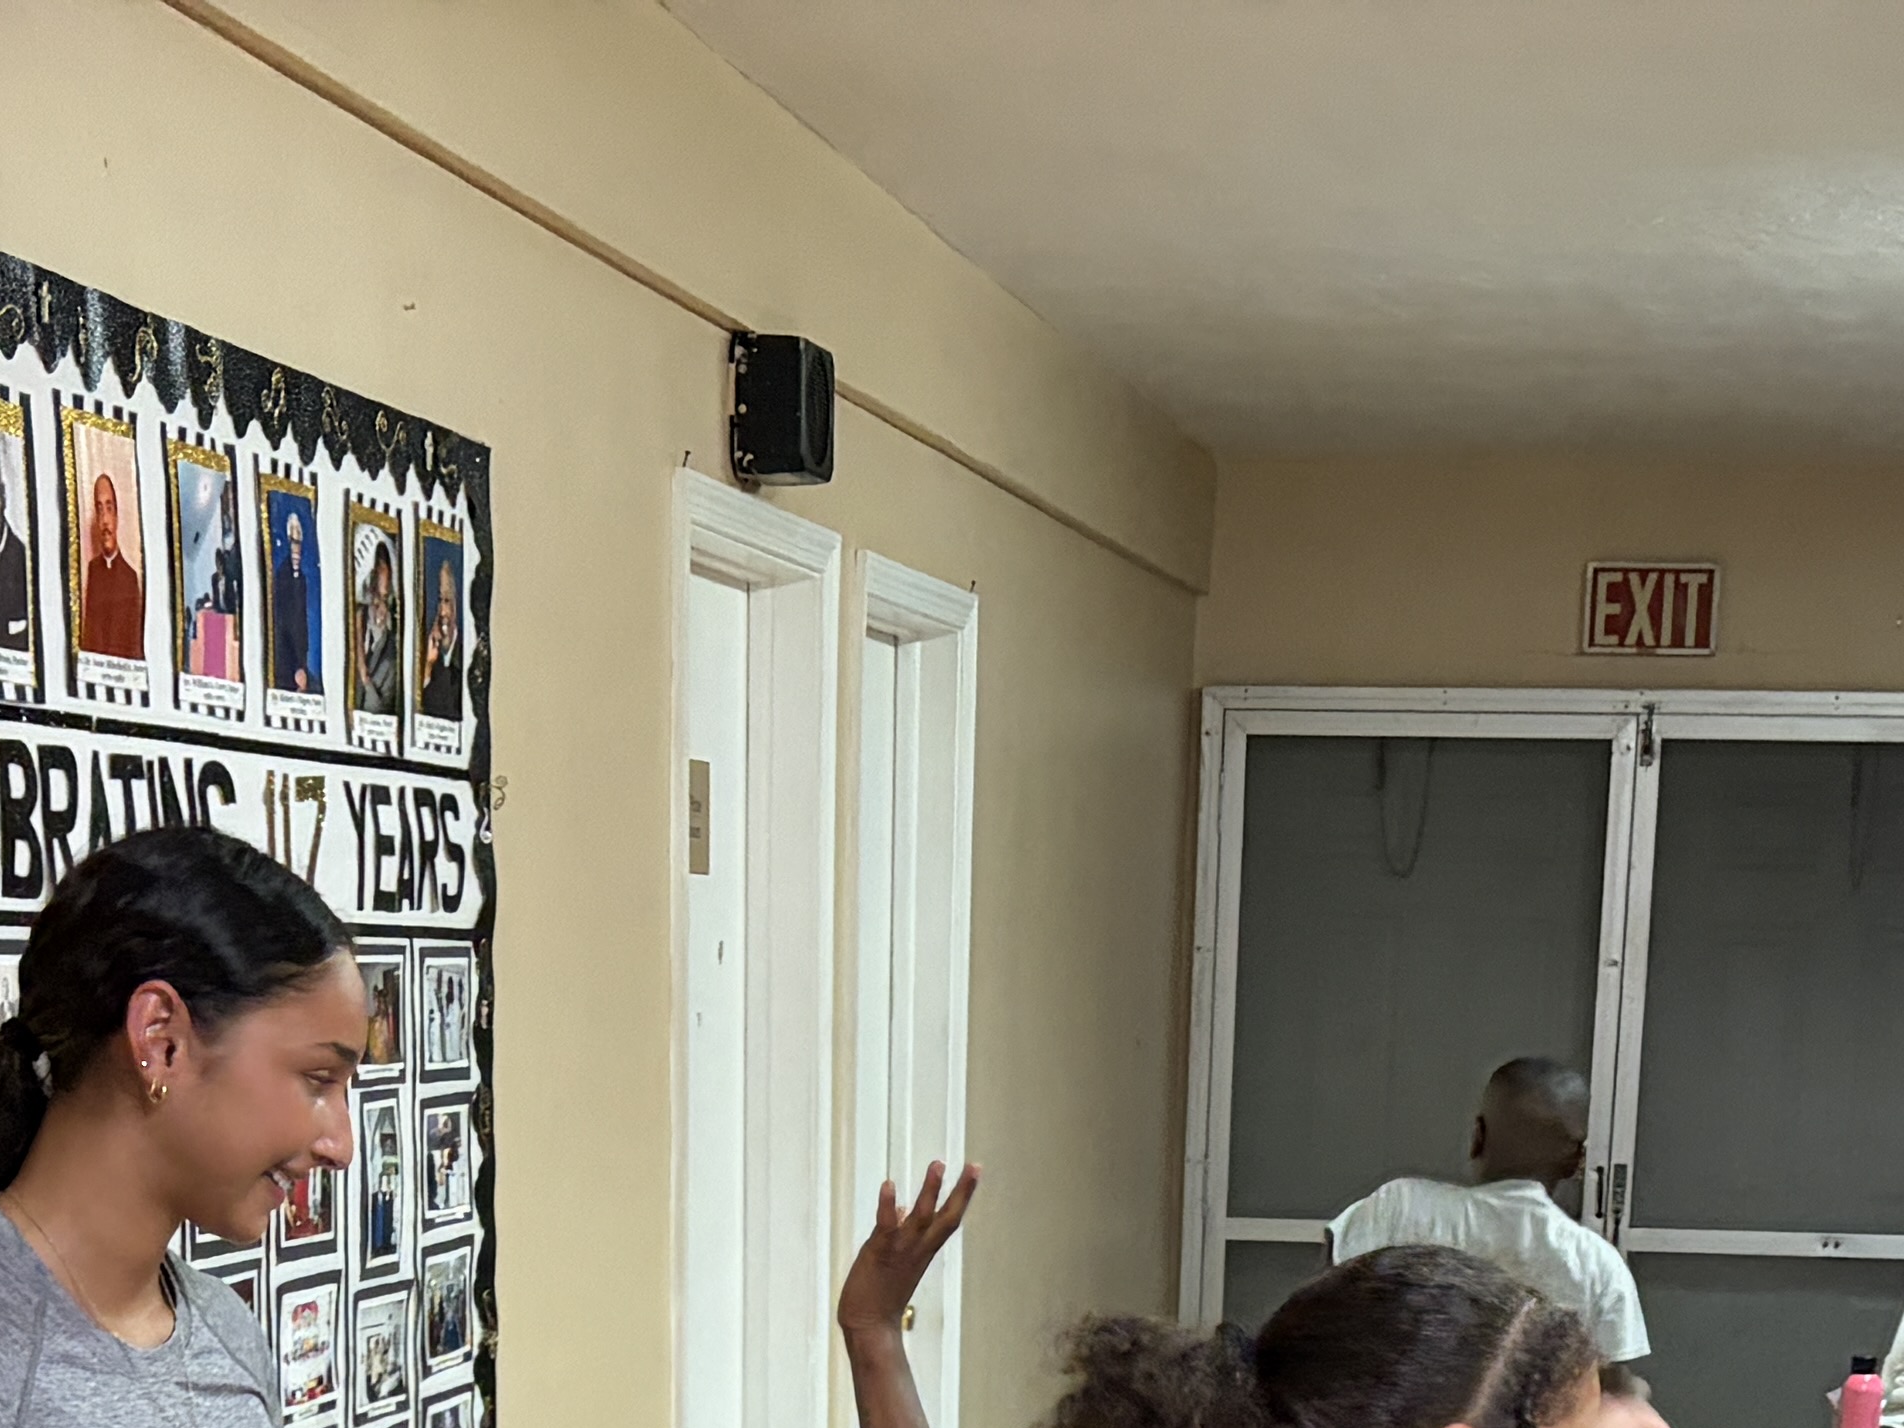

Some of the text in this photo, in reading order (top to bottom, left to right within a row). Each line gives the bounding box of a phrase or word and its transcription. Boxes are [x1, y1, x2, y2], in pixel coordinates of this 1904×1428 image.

[1593, 571, 1709, 647] EXIT
[263, 769, 327, 888] 117
[343, 780, 466, 914] YEARS
